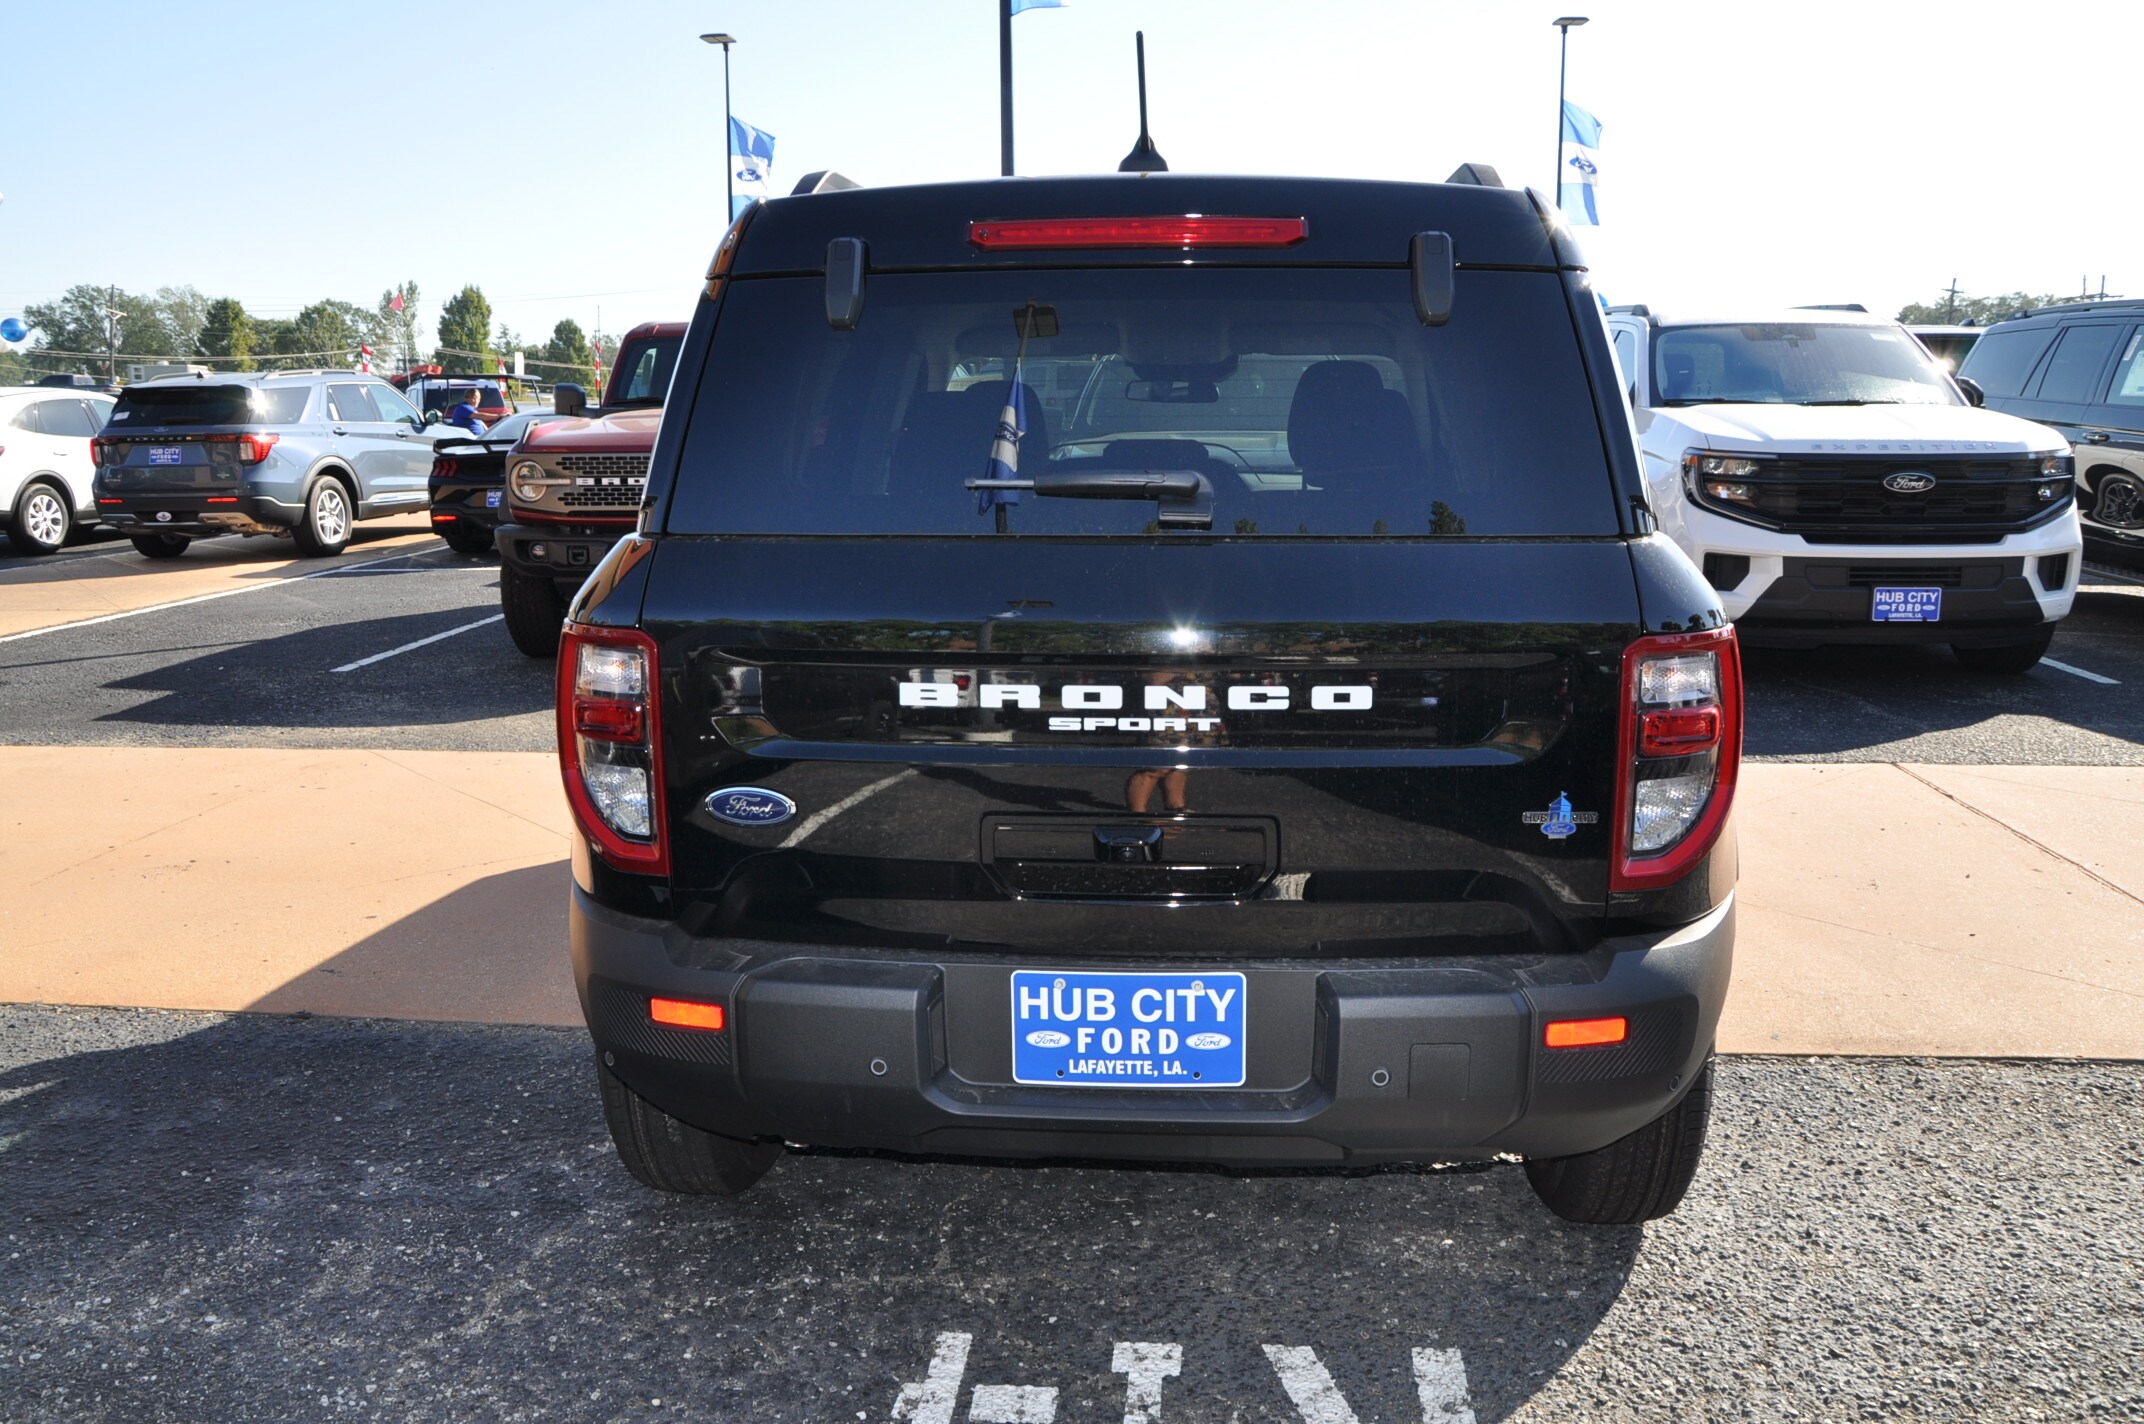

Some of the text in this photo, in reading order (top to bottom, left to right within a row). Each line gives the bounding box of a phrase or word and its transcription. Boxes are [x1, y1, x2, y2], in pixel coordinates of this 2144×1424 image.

[164, 447, 180, 455] CITY
[1811, 443, 1997, 451] EXPEDITION
[576, 477, 646, 486] BRO
[1893, 475, 1926, 489] Ford
[1876, 591, 1938, 603] HUB CITY
[1891, 603, 1922, 612] FORD
[899, 681, 1374, 711] BRONCO
[1048, 716, 1221, 732] SPORT
[725, 795, 773, 817] Ford
[1525, 813, 1596, 822] HUB CITY
[1019, 986, 1237, 1022] HUB CITY
[1034, 1033, 1062, 1045] Ford
[1077, 1027, 1179, 1055] FORD
[1193, 1034, 1222, 1047] Ford
[1068, 1058, 1188, 1078] LAFAYETTE, LA.
